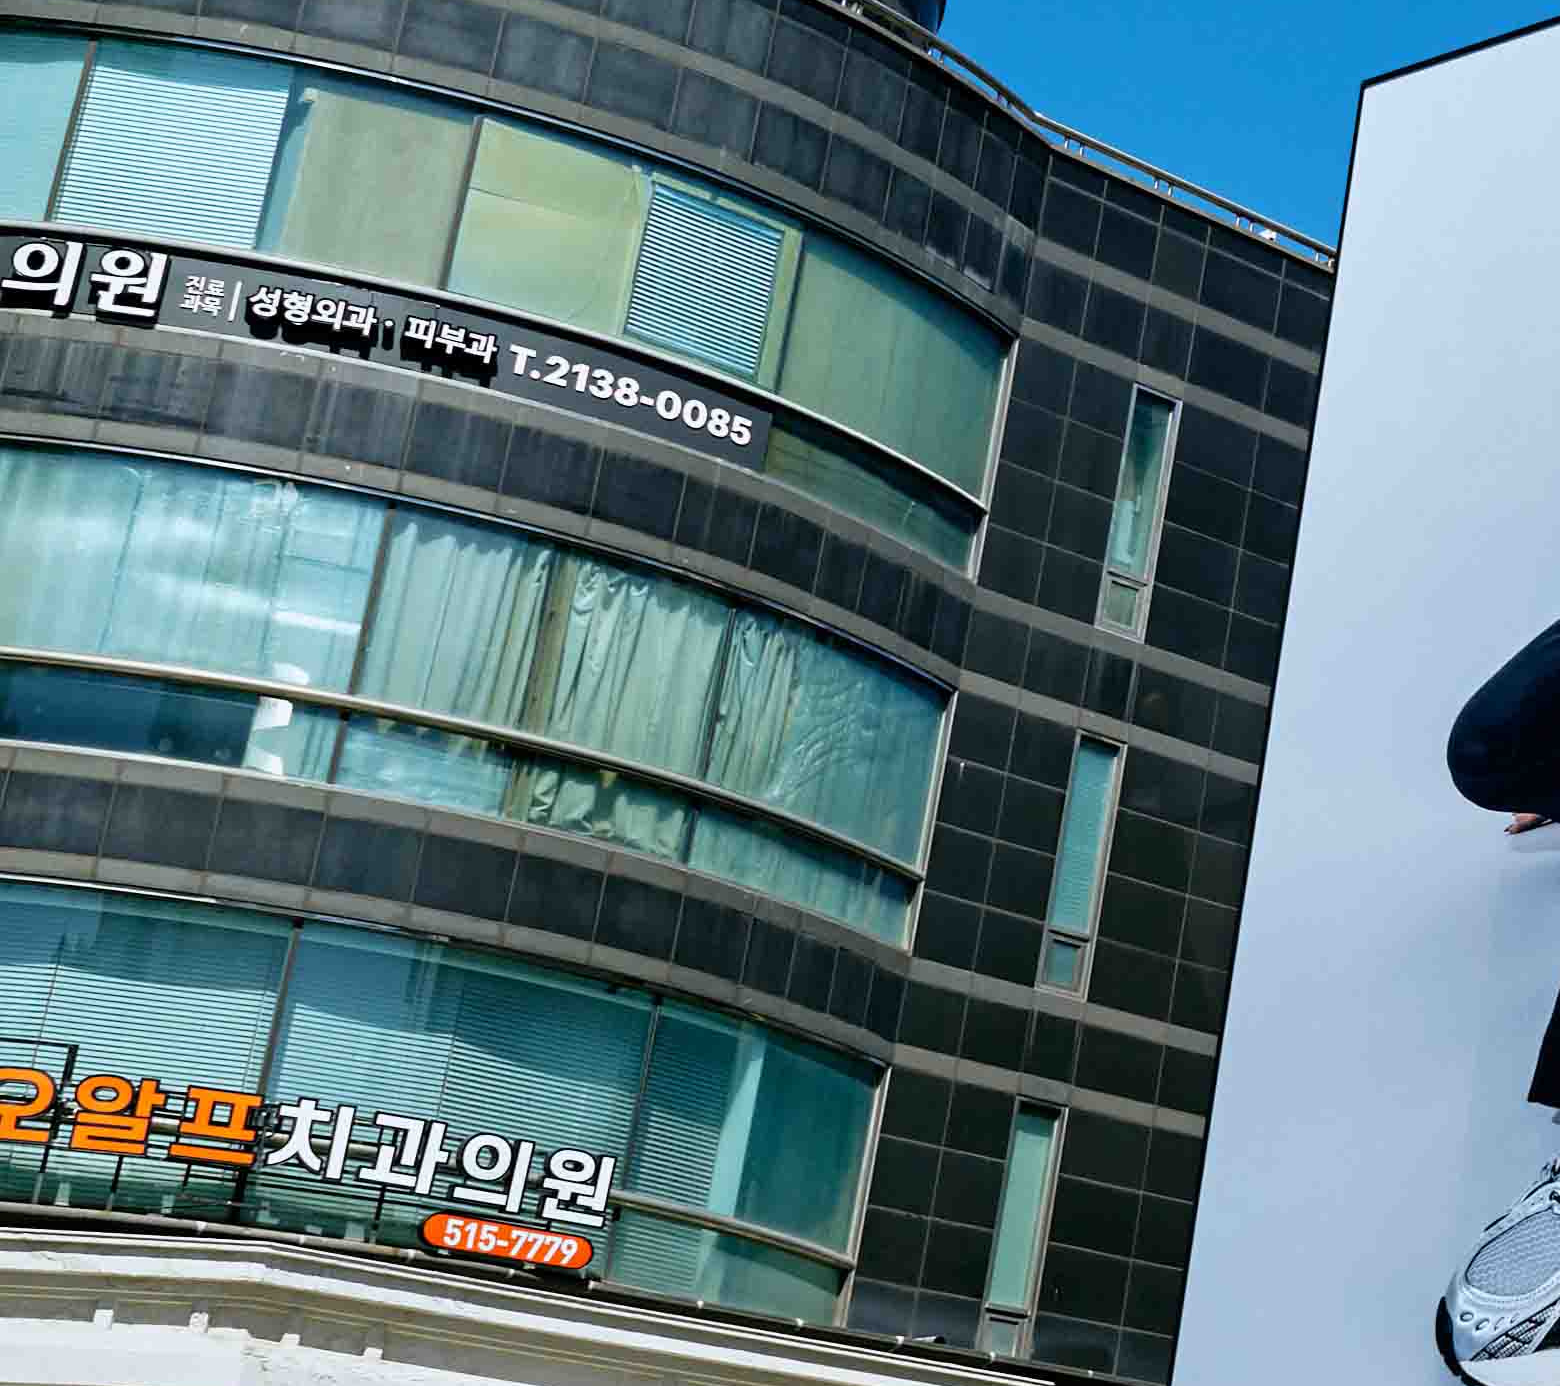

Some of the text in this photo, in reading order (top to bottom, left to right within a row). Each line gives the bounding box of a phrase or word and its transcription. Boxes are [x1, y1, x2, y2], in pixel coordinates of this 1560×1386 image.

[1, 241, 168, 317] 의원
[184, 275, 225, 297] 진료
[179, 294, 224, 317] 과목
[250, 286, 753, 446] 성형외과 피부과 T.2138-0085
[444, 1217, 579, 1265] 515-7779
